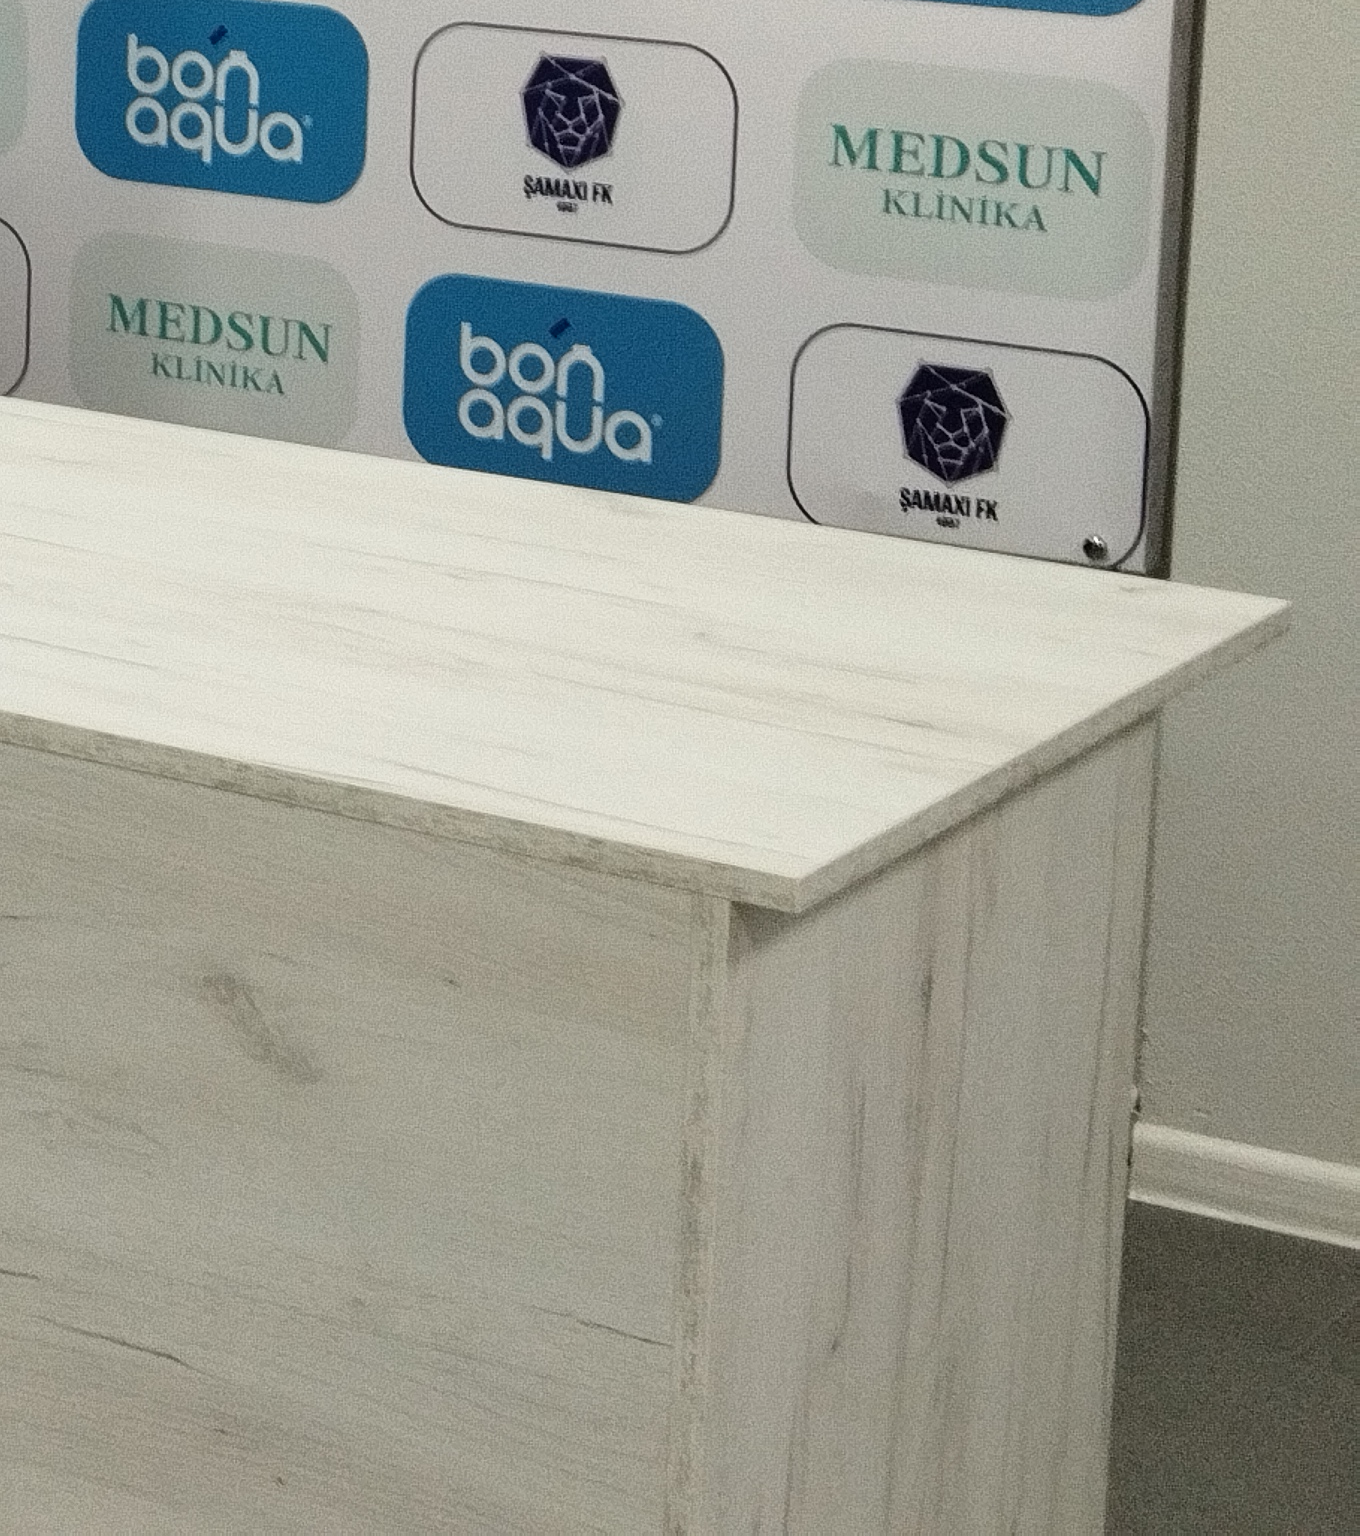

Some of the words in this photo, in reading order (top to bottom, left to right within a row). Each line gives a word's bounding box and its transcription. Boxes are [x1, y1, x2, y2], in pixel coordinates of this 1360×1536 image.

[125, 31, 260, 105] bon
[123, 96, 305, 164] aqua
[827, 122, 1109, 197] MEDSUN
[590, 182, 614, 206] FK
[105, 292, 336, 365] MEDSUN
[458, 319, 605, 402] bon
[456, 387, 654, 464] aqua
[900, 486, 970, 518] ŞAMAXI
[973, 497, 999, 523] FK
